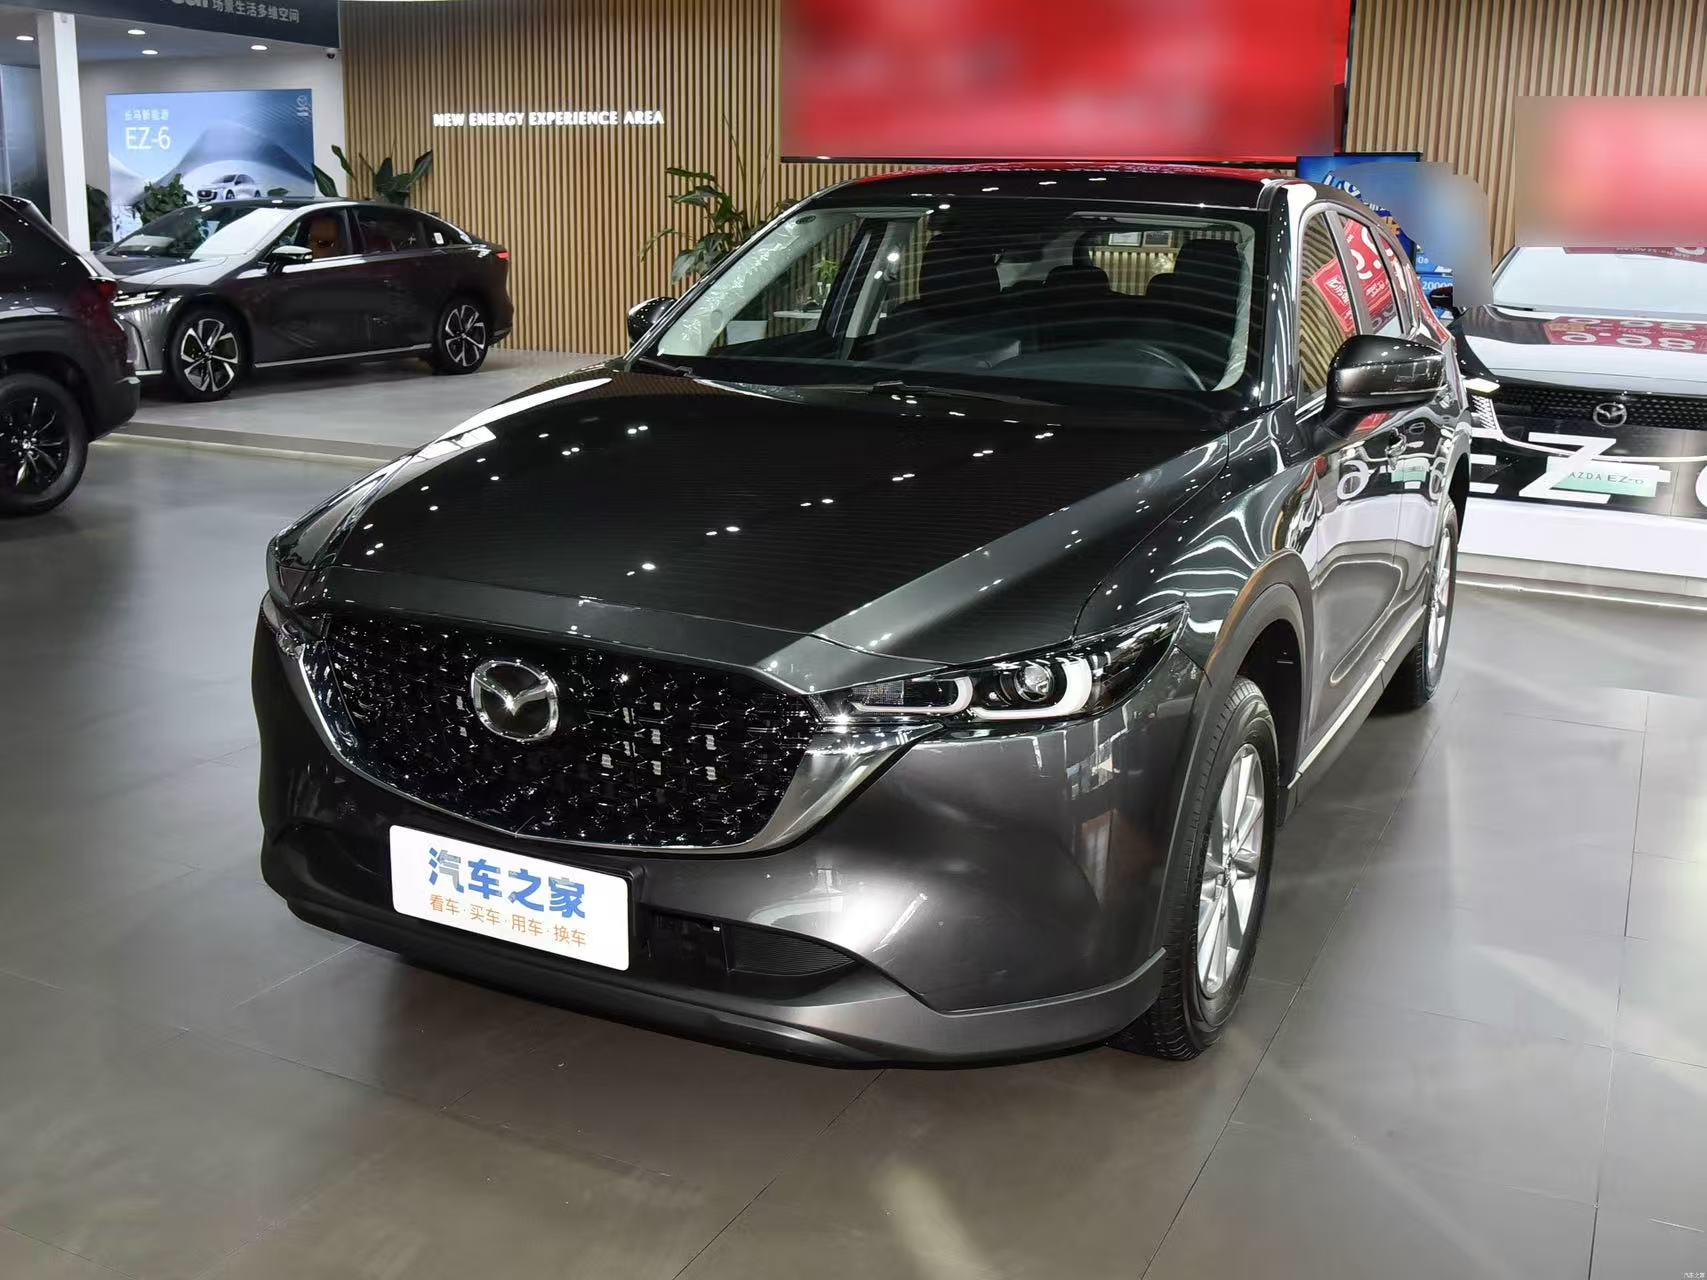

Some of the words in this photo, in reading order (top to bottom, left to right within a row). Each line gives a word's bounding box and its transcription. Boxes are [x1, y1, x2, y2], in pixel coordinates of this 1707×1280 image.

[432, 113, 465, 127] NEW
[469, 112, 525, 127] ENERGY
[529, 110, 618, 126] EXPERIENCE
[623, 110, 664, 125] AREA
[126, 126, 171, 150] EZ-6
[428, 847, 586, 919] 汽车之家
